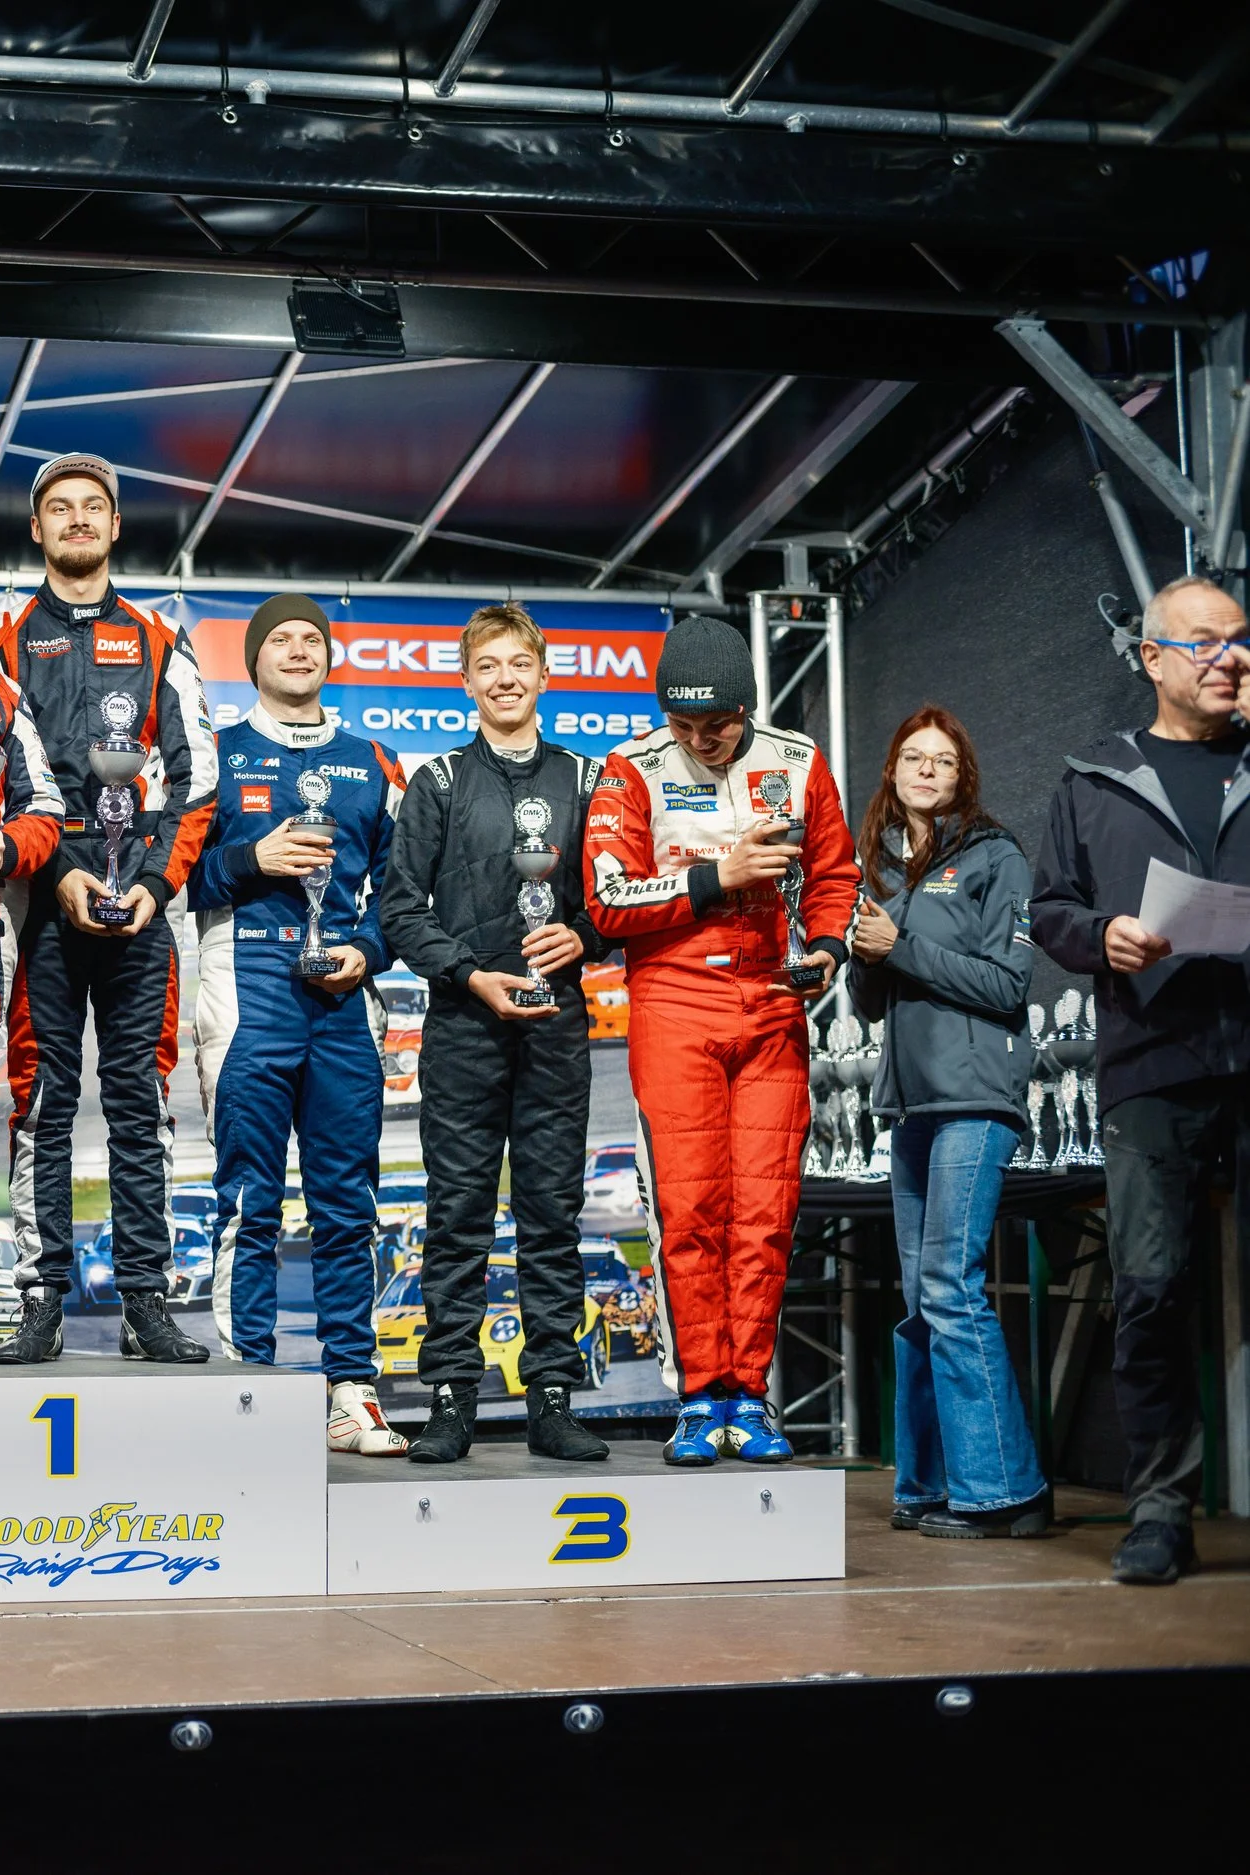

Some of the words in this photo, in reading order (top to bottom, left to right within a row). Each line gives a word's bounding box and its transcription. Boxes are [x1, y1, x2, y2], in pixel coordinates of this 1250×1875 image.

[72, 607, 100, 620] freem
[27, 635, 71, 648] HAMPL
[96, 638, 138, 652] DMV
[28, 643, 71, 654] MOTORS
[667, 685, 715, 700] CUNTZ
[109, 703, 128, 711] DMV
[554, 711, 654, 737] 2025
[292, 732, 320, 743] freem
[784, 747, 808, 760] OMP
[640, 757, 661, 769] OMP
[233, 772, 279, 782] Motorsport
[319, 764, 369, 783] CUNTZ
[425, 760, 450, 789] sparco
[305, 780, 323, 789] DMV
[664, 784, 716, 797] GOODYEAR
[244, 795, 268, 804] DMV
[589, 814, 620, 828] DMV
[685, 847, 716, 857] BMW
[238, 926, 268, 939] freem
[29, 1393, 80, 1479] 1
[548, 1492, 632, 1565] 3
[85, 1550, 221, 1586] Days
